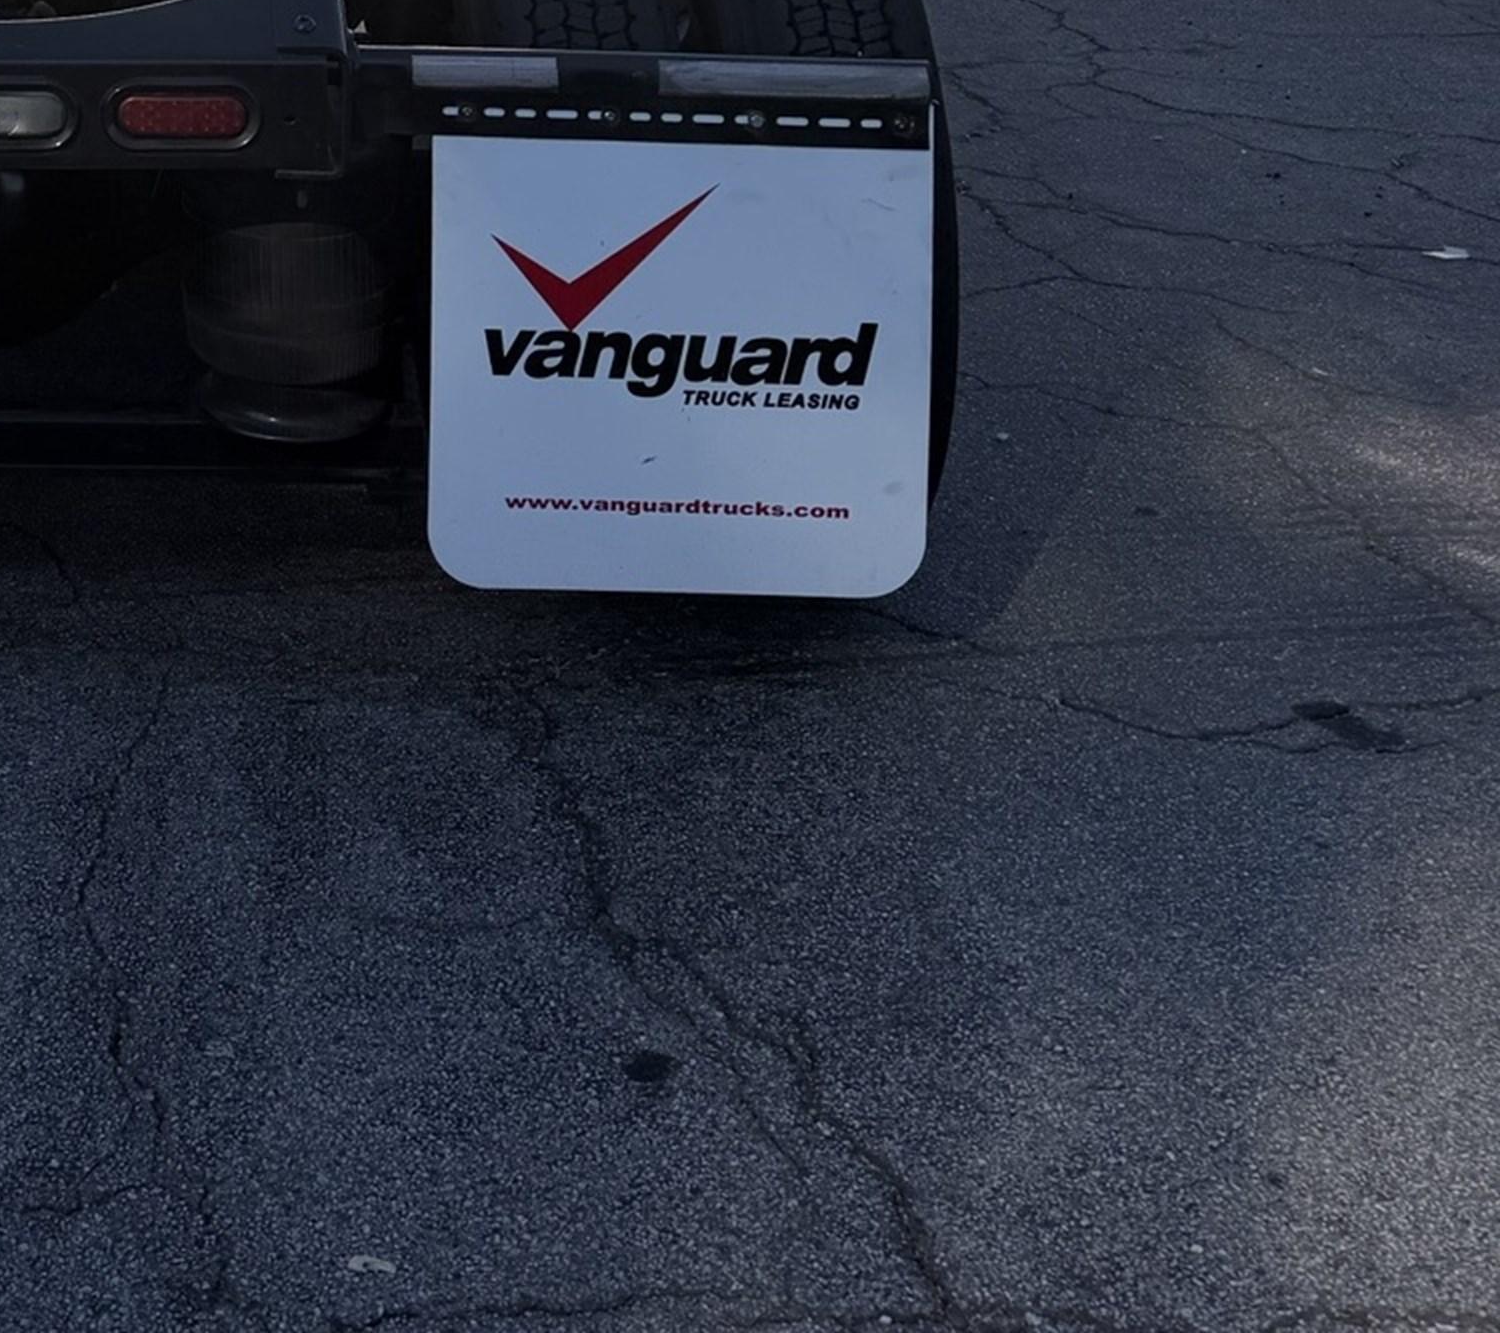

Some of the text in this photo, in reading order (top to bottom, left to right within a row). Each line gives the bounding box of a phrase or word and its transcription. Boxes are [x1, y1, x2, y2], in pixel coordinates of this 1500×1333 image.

[483, 322, 879, 398] vanguard
[682, 390, 861, 410] TRUCK LEASING
[504, 496, 850, 519] www.vanguardtrucks.com
